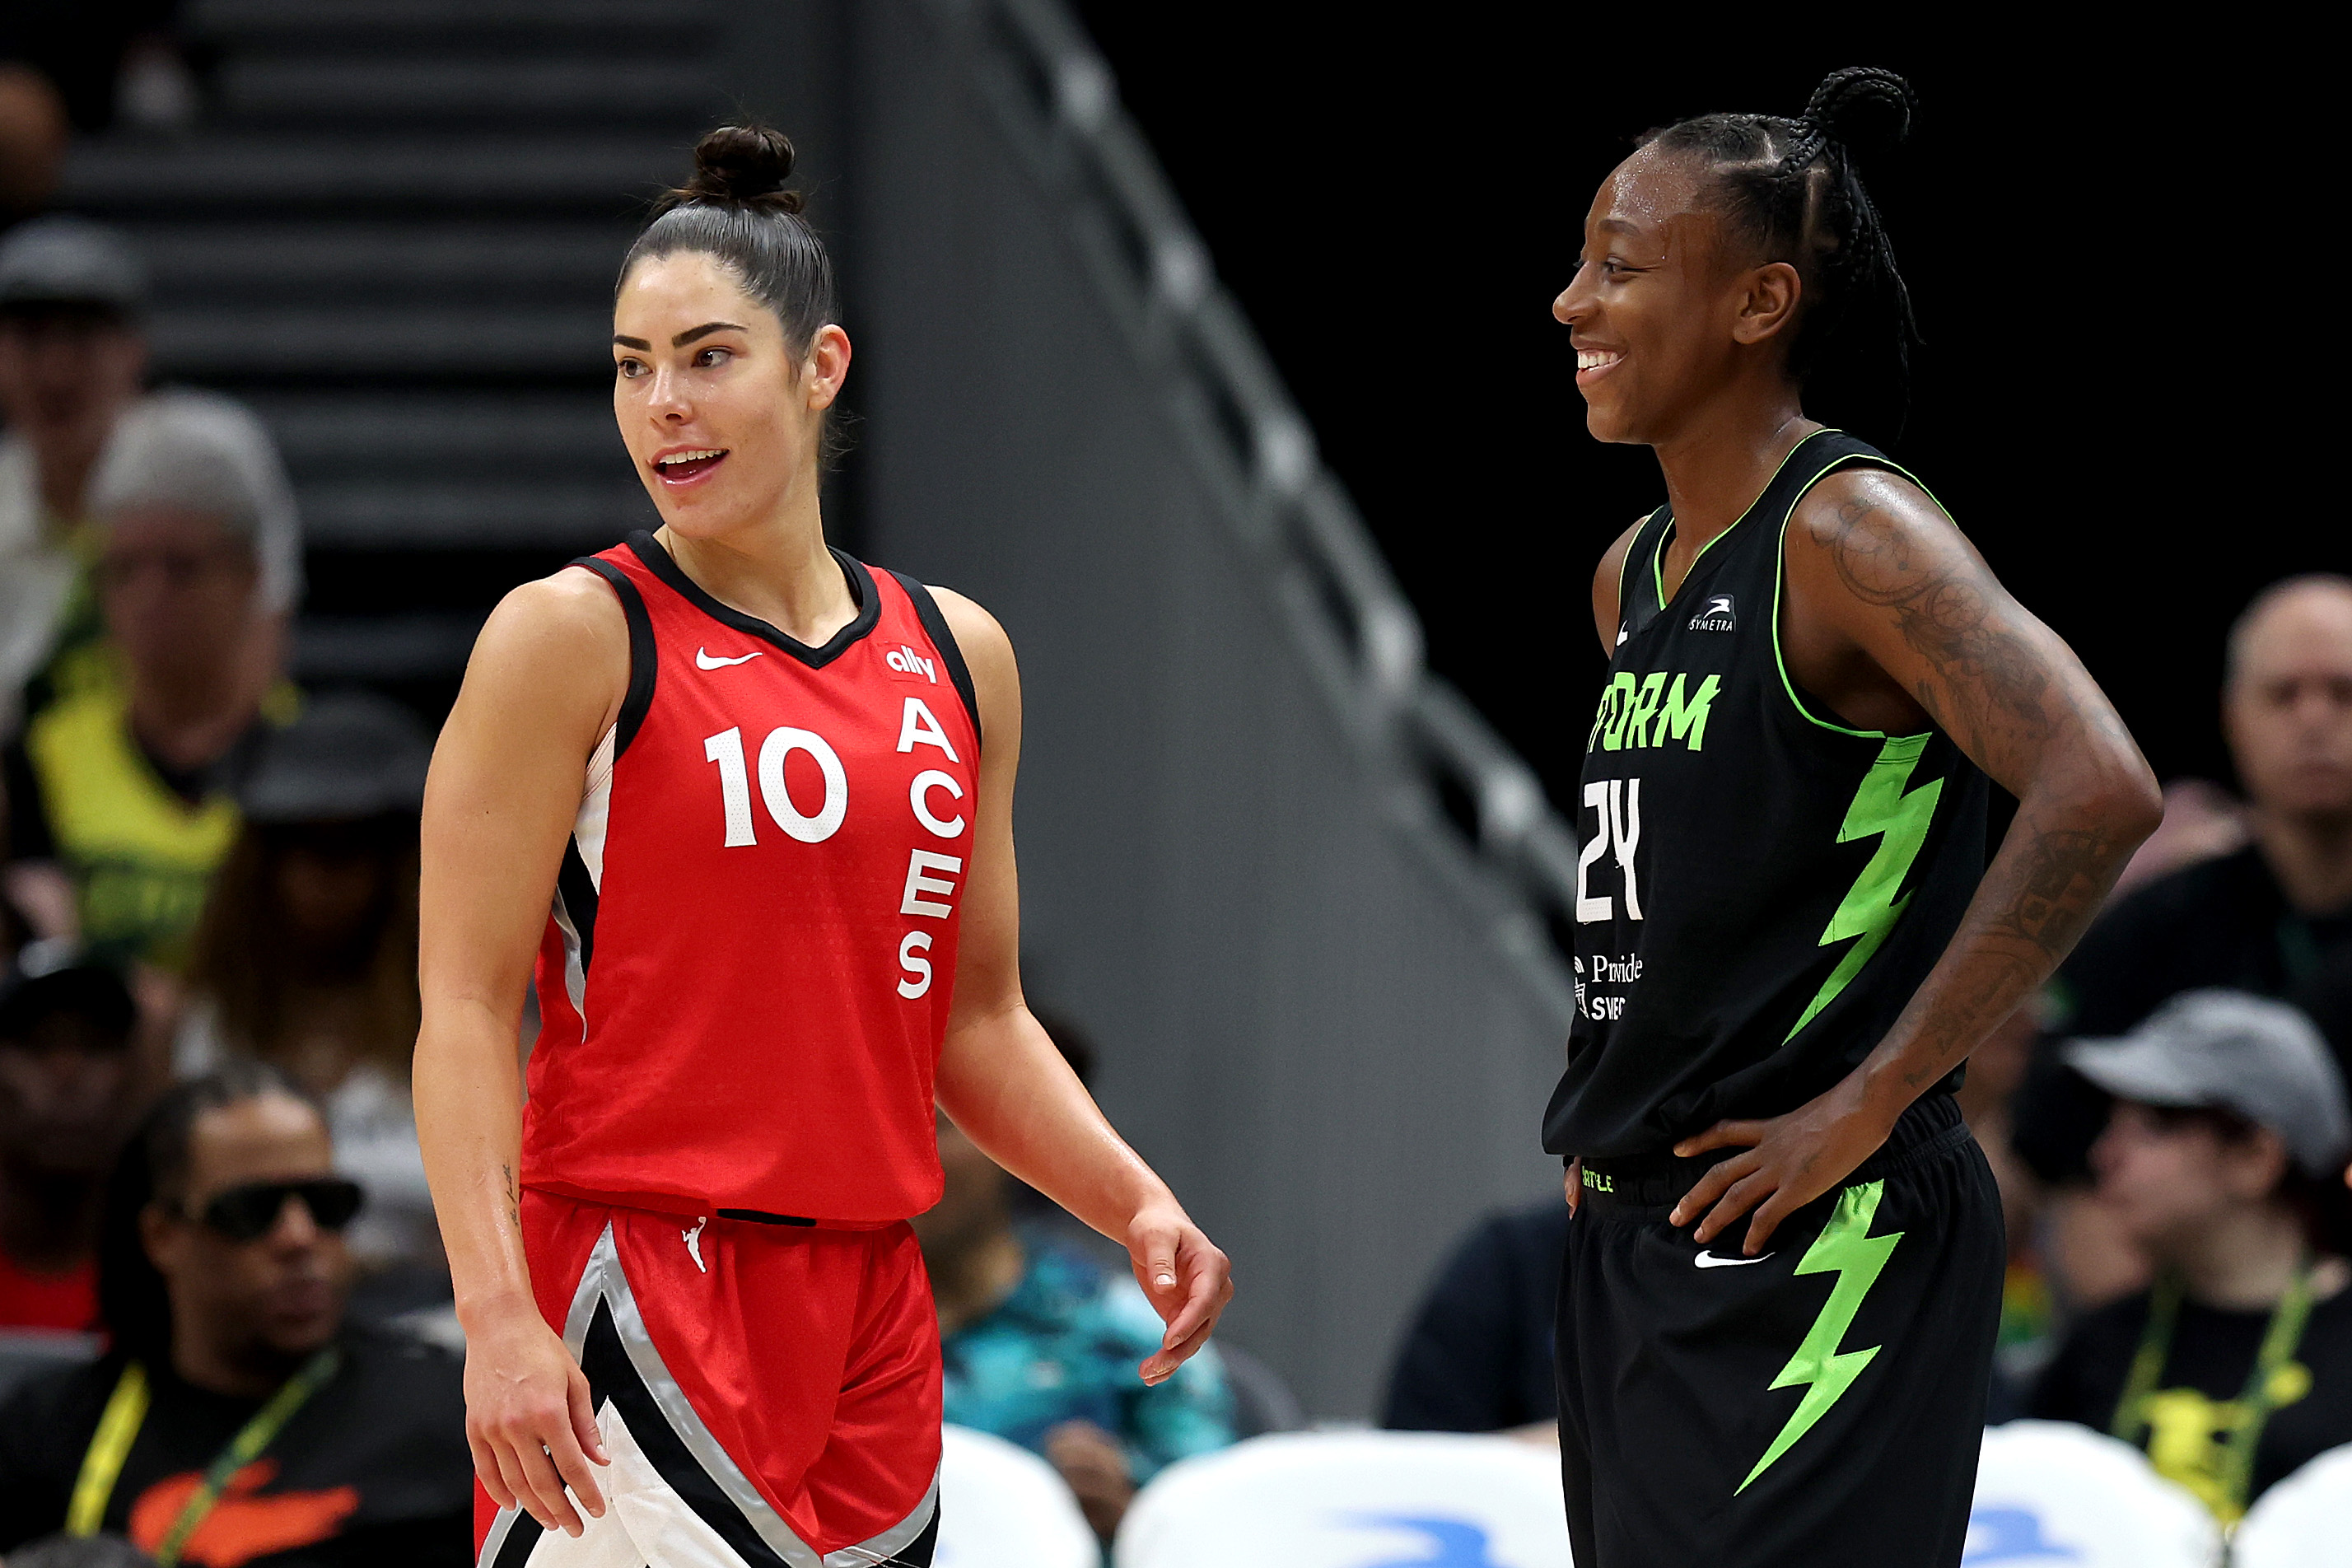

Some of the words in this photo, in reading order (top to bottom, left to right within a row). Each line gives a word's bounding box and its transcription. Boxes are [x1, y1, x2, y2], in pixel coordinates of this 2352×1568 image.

[886, 644, 936, 684] ally
[1689, 618, 1732, 632] SYMETRA
[703, 726, 848, 847] 10
[897, 697, 965, 1000] ACES
[1576, 777, 1644, 923] 24
